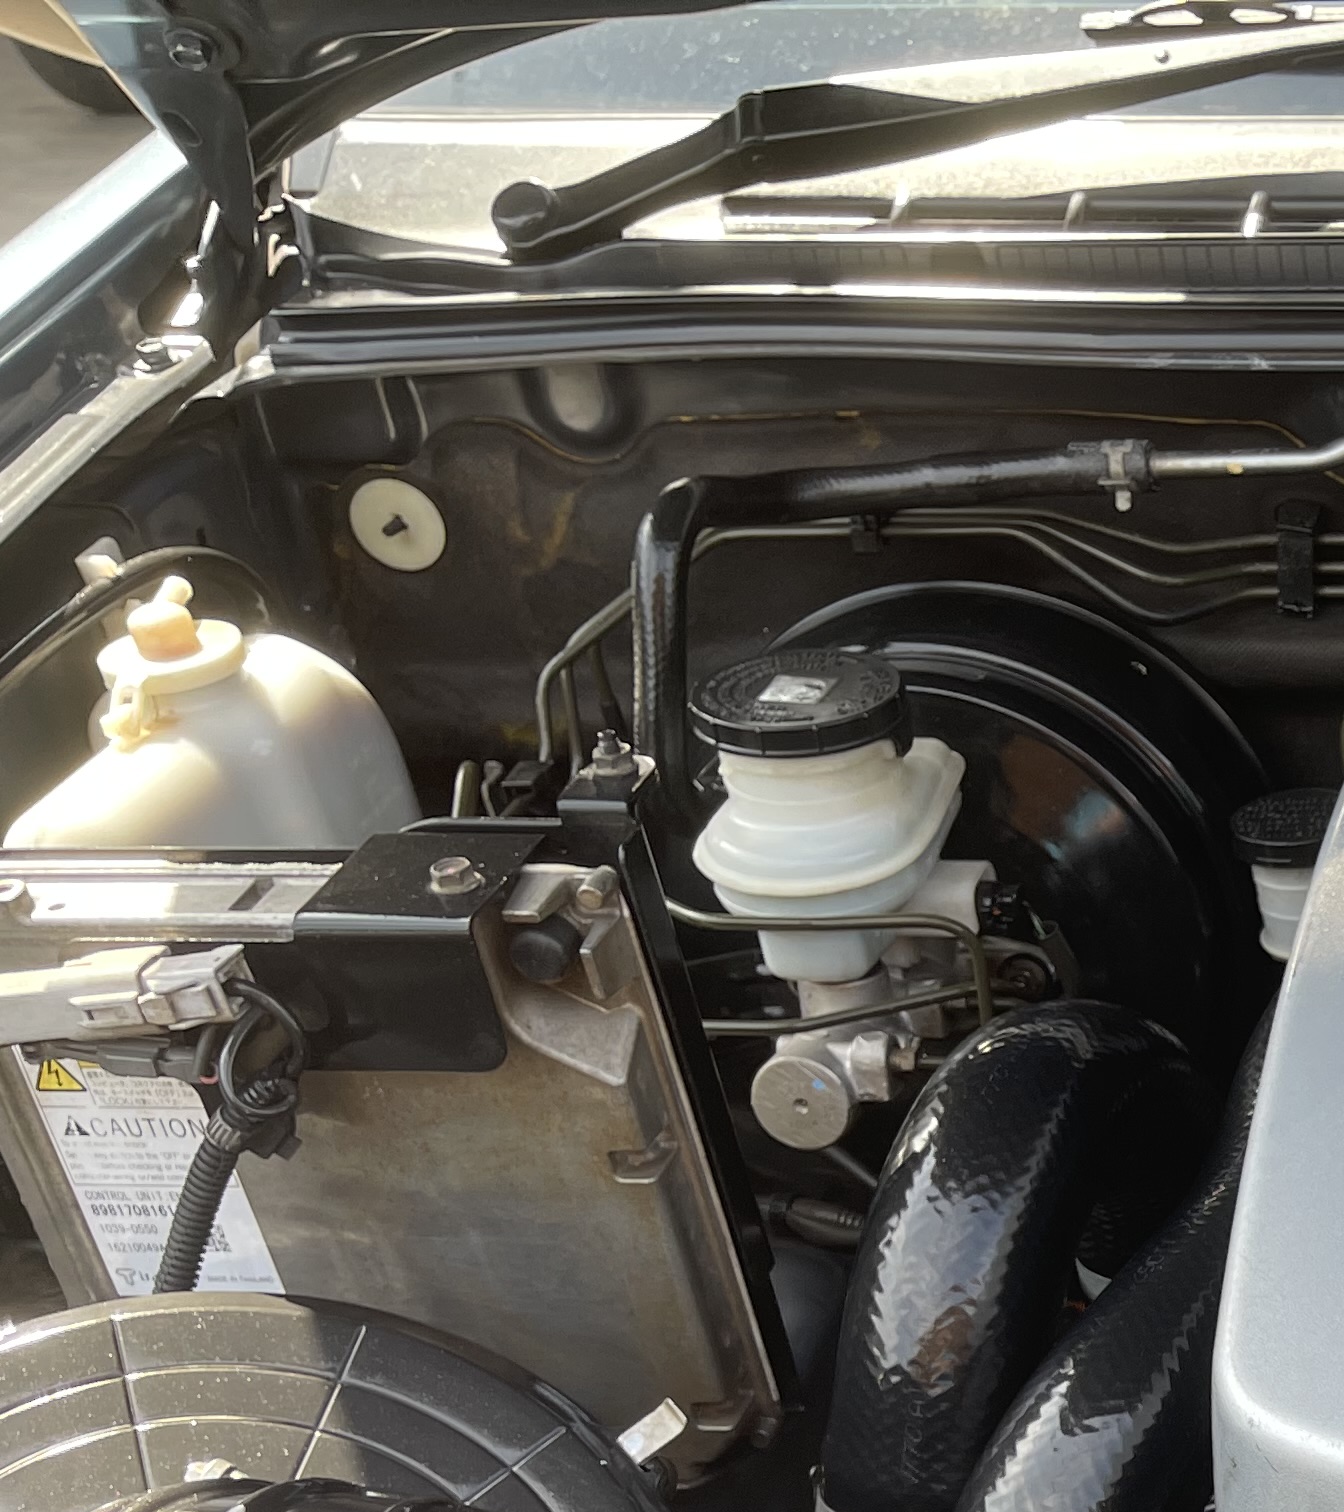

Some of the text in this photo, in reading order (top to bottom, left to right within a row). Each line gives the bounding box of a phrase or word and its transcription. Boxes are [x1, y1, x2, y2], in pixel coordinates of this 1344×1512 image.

[90, 1118, 206, 1138] CAUTION
[84, 1190, 131, 1201] CONTROL
[135, 1190, 163, 1201] UNIT
